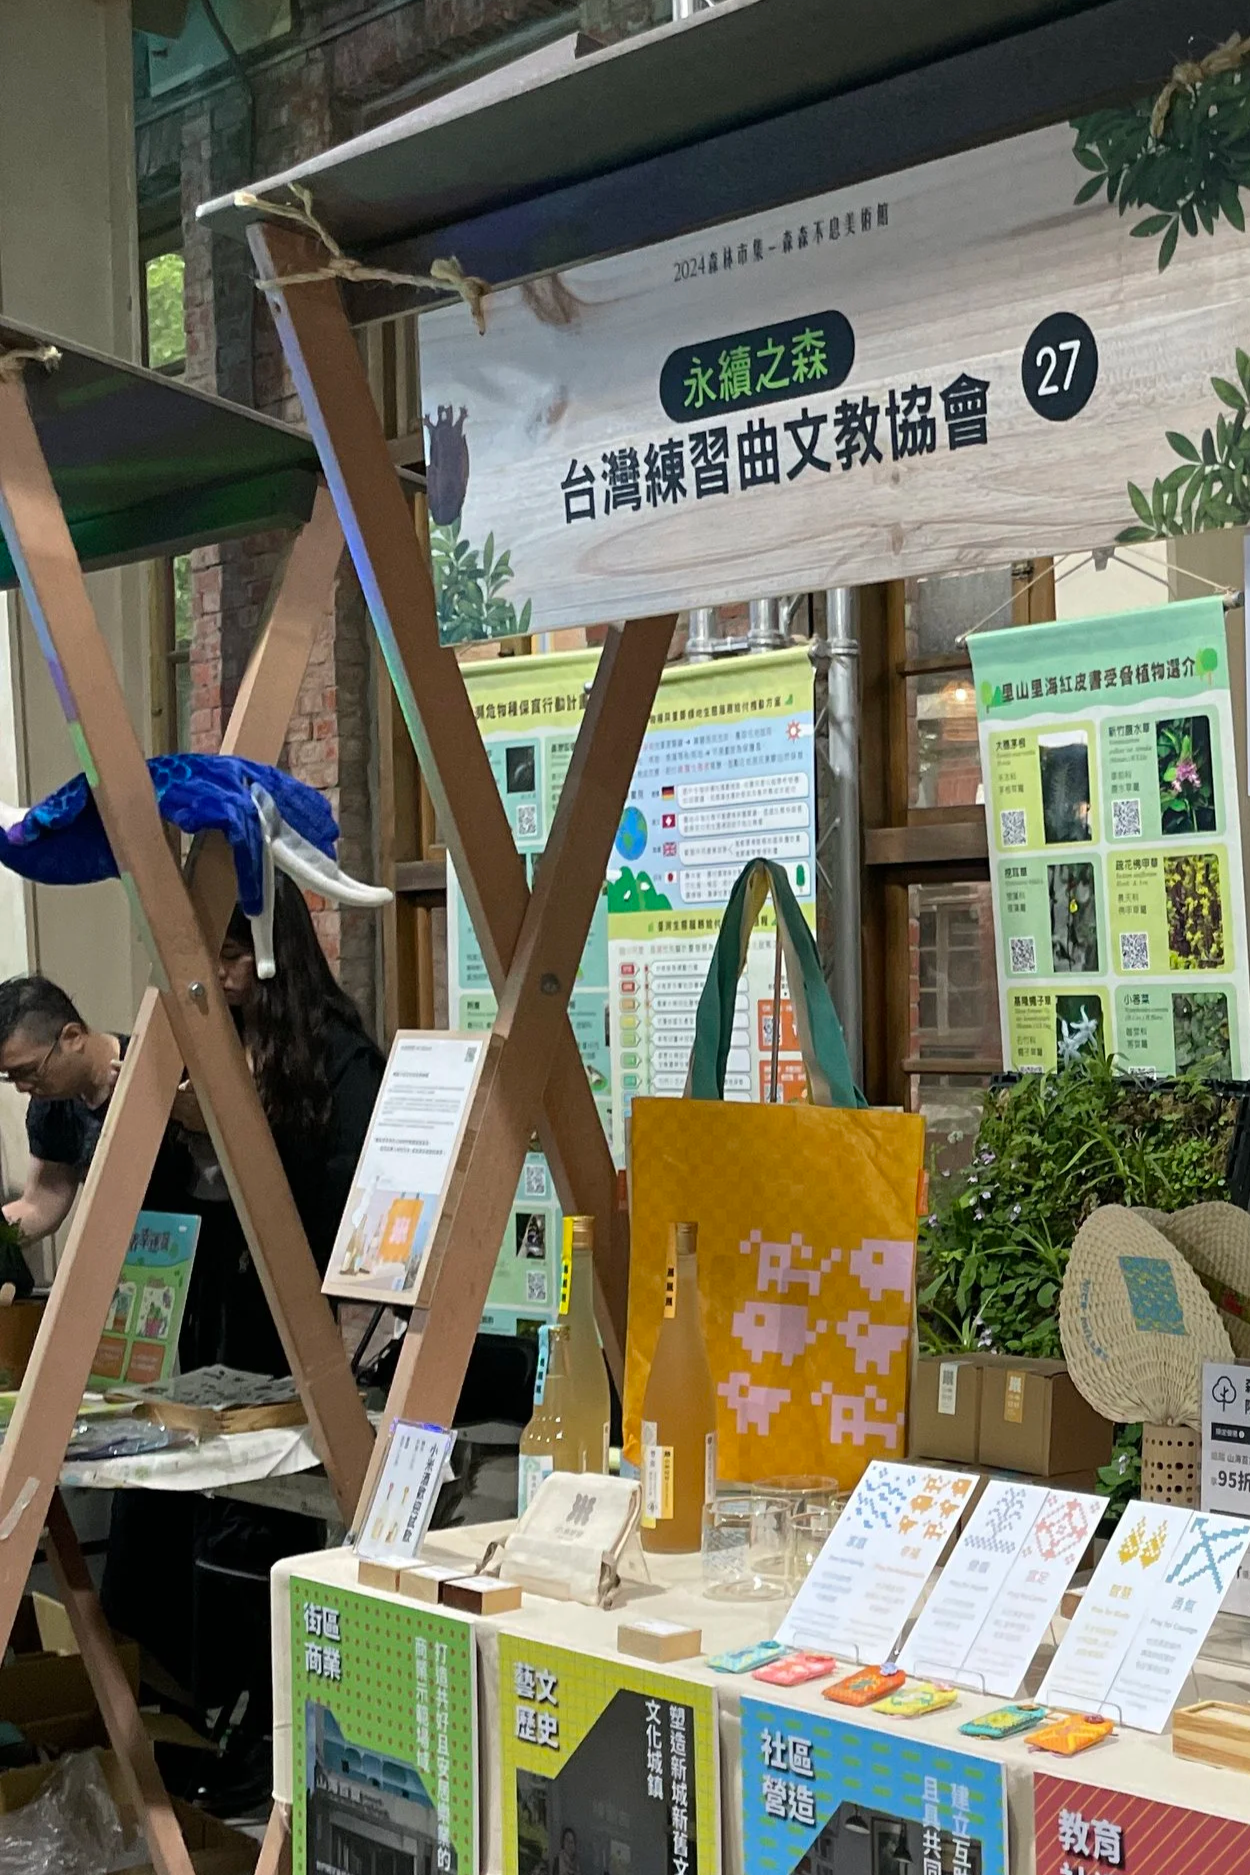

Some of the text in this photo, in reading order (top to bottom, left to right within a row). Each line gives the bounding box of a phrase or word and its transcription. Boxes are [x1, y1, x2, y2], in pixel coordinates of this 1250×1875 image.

[683, 327, 829, 410] 永續之森
[1034, 340, 1081, 397] 27
[560, 372, 989, 525] 台灣練習曲文教協會
[303, 1601, 341, 1642] 街區
[303, 1641, 342, 1682] 商業
[513, 1661, 558, 1708] 藝文
[514, 1705, 560, 1750] 歷史
[644, 1698, 664, 1801] 文化城鎮
[761, 1727, 815, 1778] 社區
[761, 1774, 816, 1827] 營造
[1058, 1808, 1122, 1864] 教育
